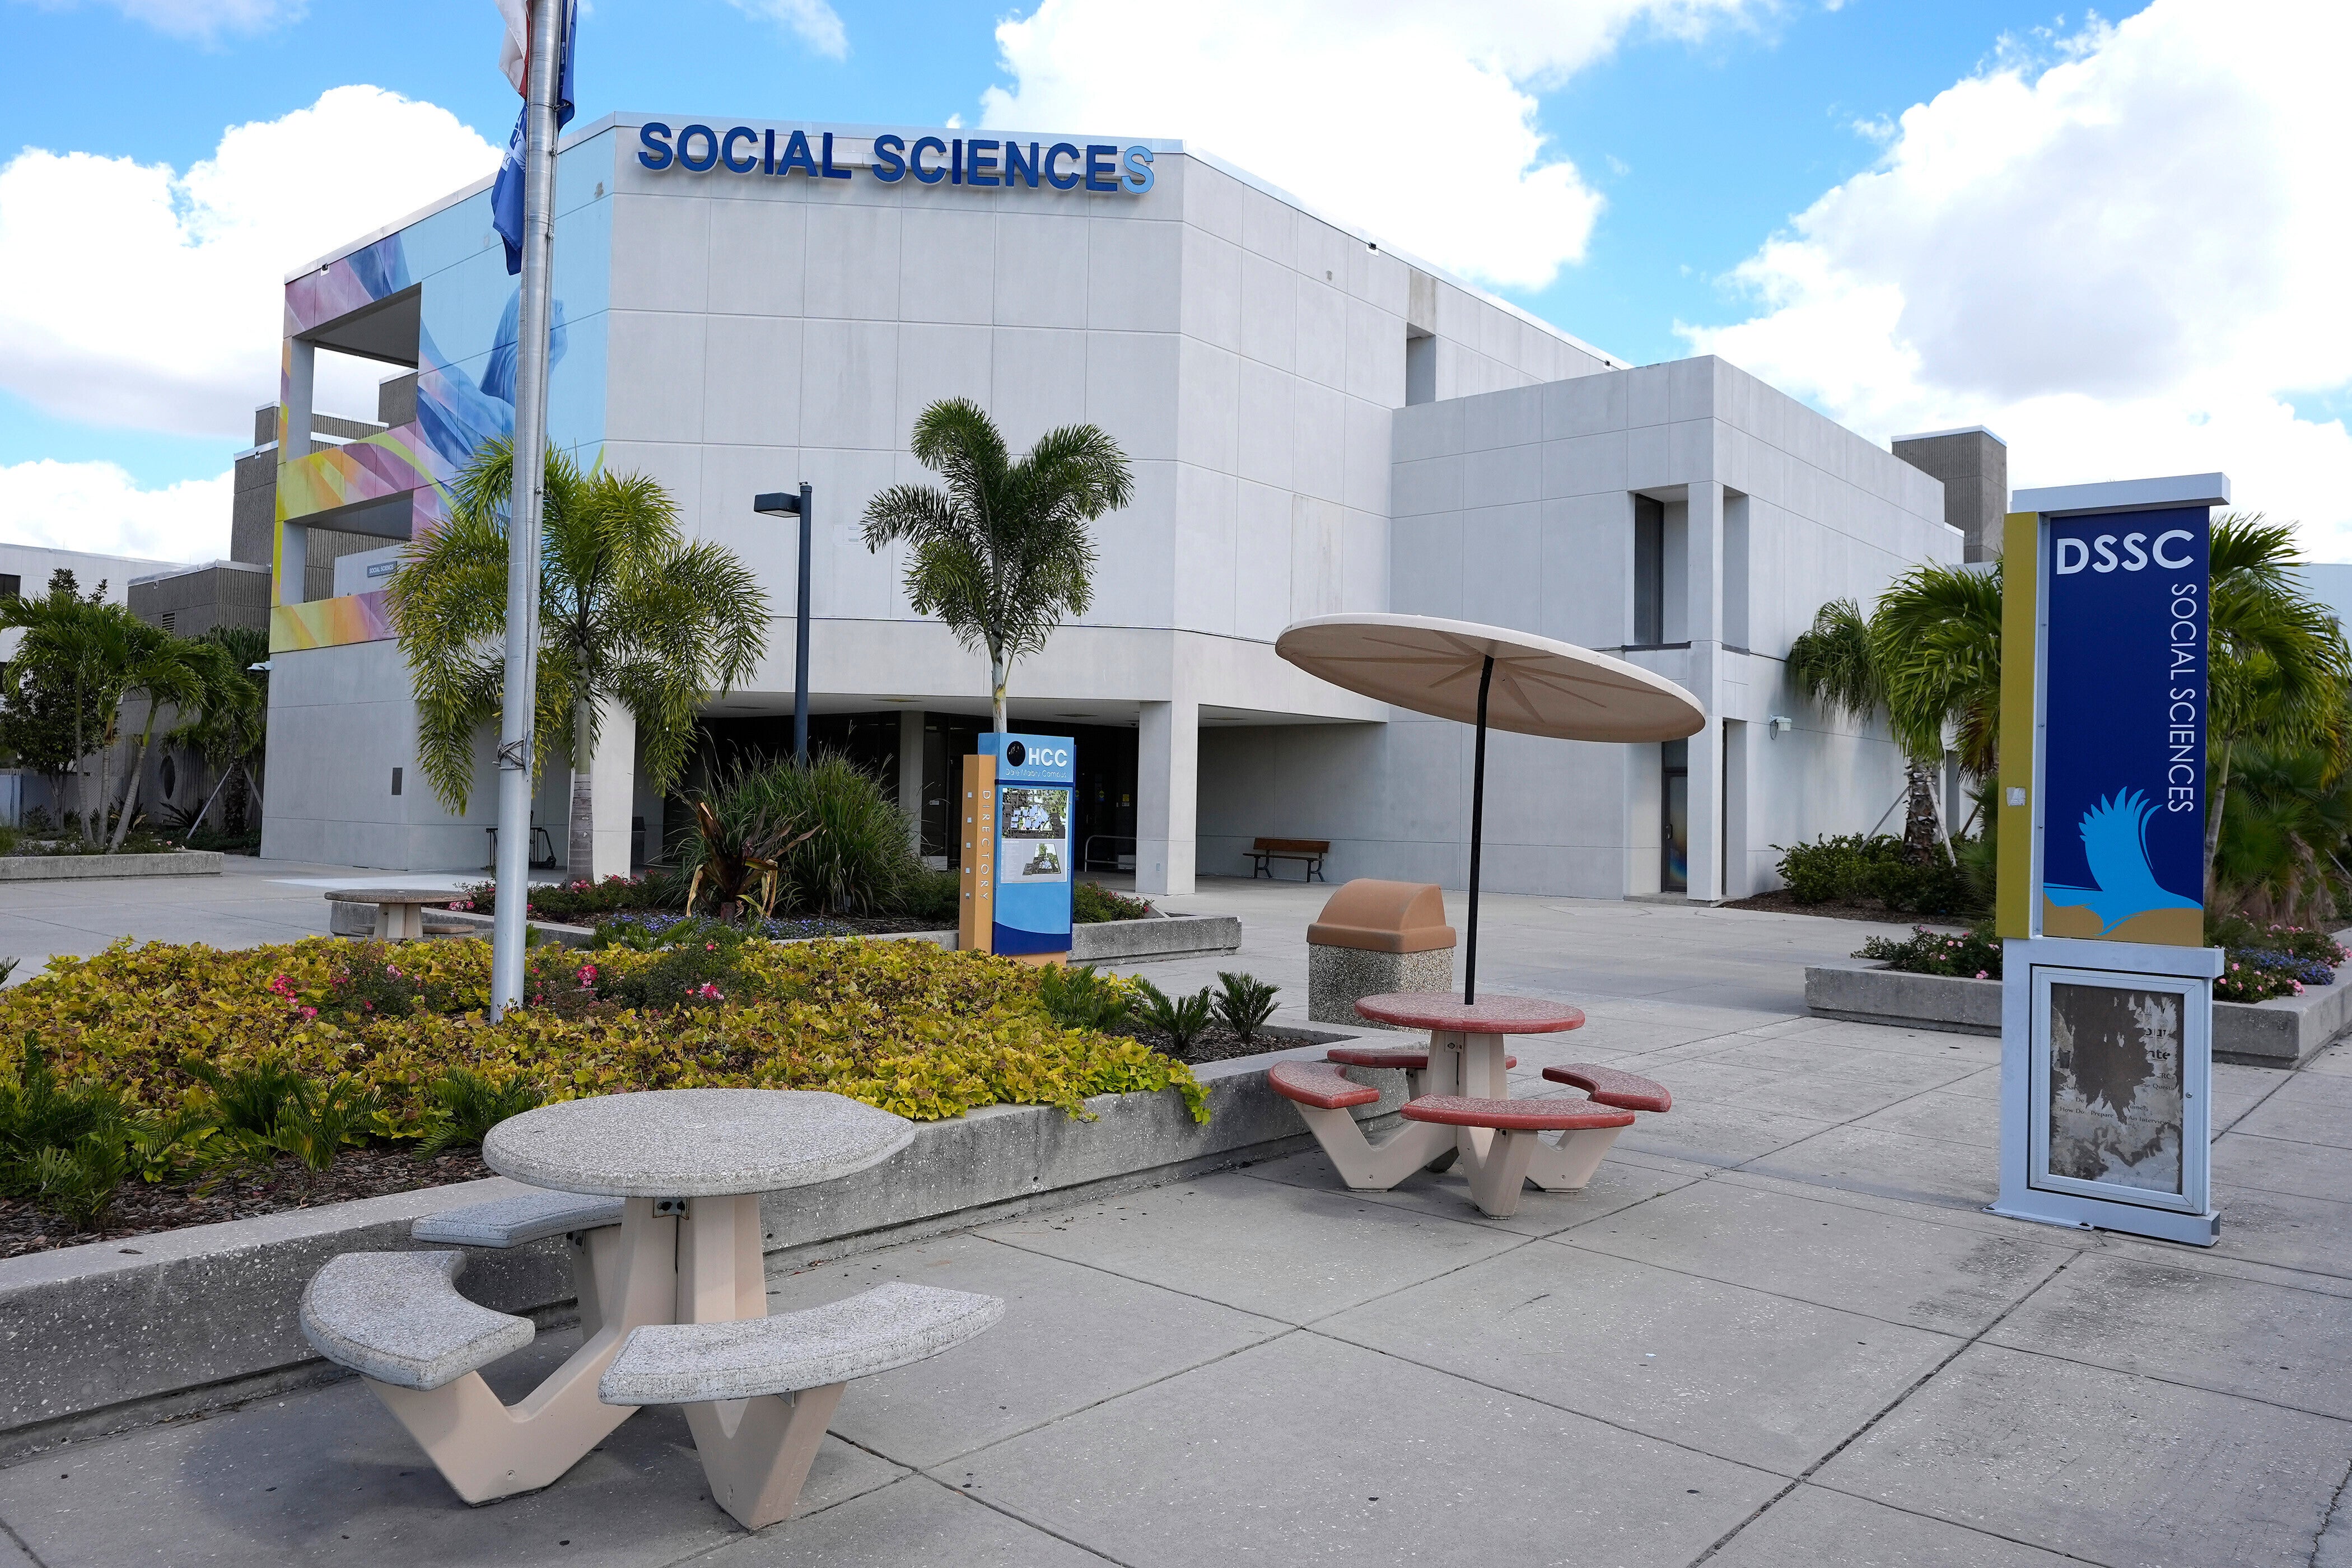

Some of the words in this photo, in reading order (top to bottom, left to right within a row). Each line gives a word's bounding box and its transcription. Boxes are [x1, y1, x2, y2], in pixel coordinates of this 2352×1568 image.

[638, 122, 852, 180] SOCIAL
[872, 134, 1154, 194] SCIENCES
[2056, 529, 2195, 575] DSSC
[2170, 584, 2197, 680] SOCIAL
[1021, 769, 1041, 778] Mabry
[1042, 770, 1067, 778] Campus
[1028, 747, 1067, 768] HCC
[2168, 687, 2196, 813] SCIENCES
[980, 790, 991, 900] DIRECTORY
